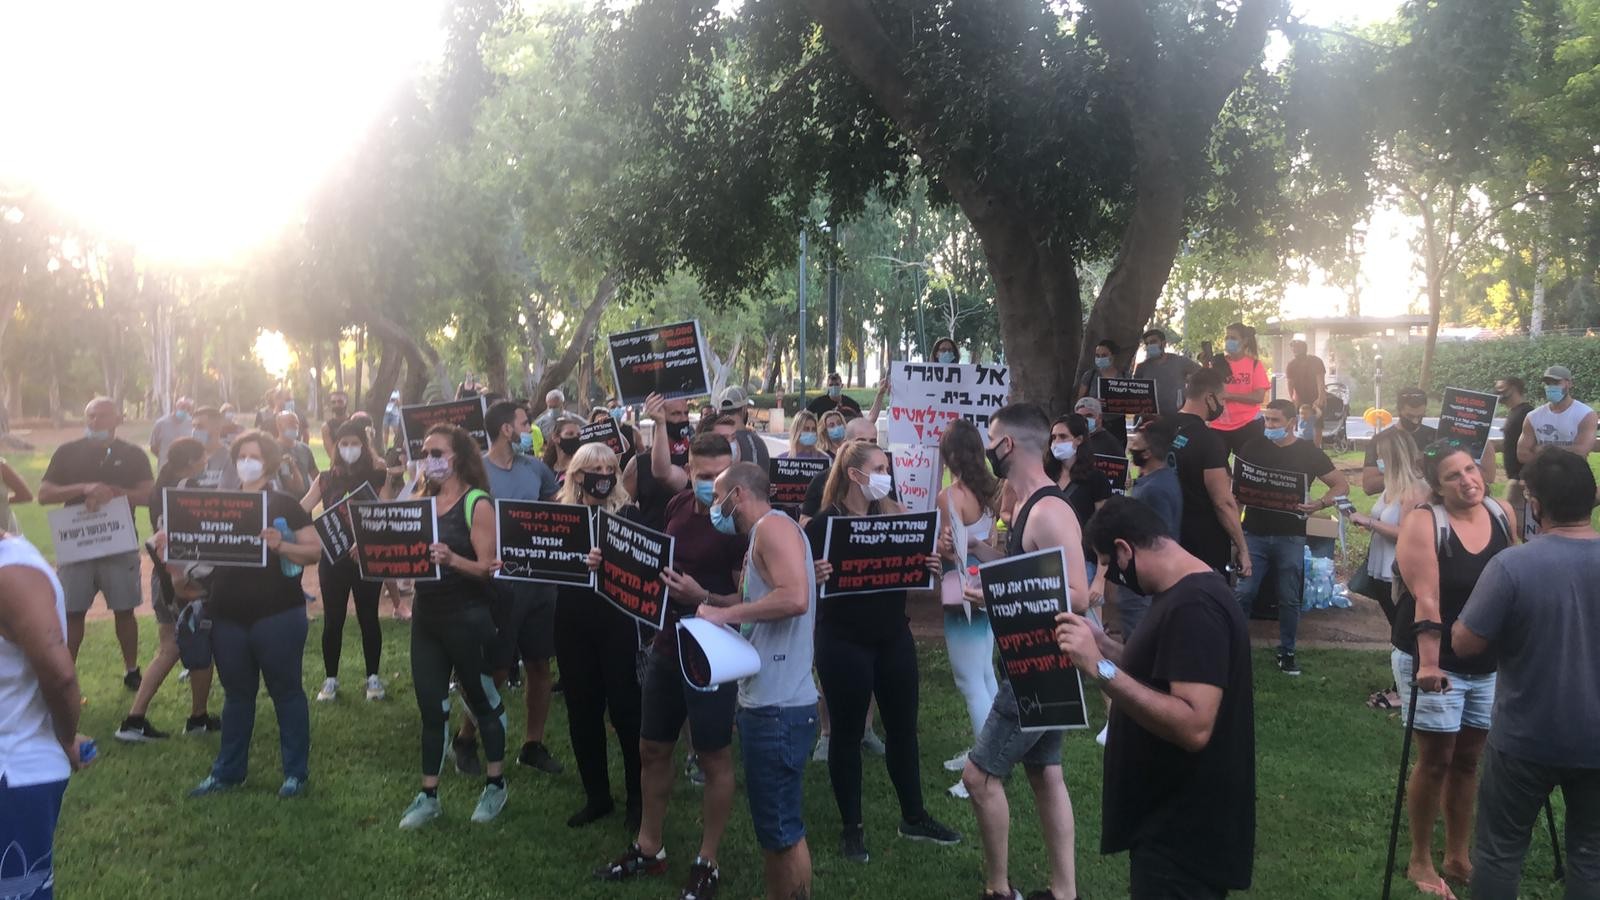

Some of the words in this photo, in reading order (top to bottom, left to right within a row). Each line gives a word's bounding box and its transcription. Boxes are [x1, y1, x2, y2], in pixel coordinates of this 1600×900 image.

[904, 365, 961, 384] תסגרו
[976, 365, 1007, 386] אל
[941, 391, 972, 406] בית
[977, 394, 1005, 407] את
[373, 508, 386, 518] את
[508, 510, 532, 519] פנאי
[535, 512, 549, 520] לא
[552, 514, 580, 524] אנחנו
[200, 521, 234, 532] אנחנו
[552, 524, 570, 534] ולא
[608, 518, 620, 533] ענף
[850, 520, 872, 533] ענף
[872, 520, 890, 531] את
[892, 520, 928, 530] שחררו
[620, 526, 632, 539] את
[849, 532, 887, 545] לעבוד!
[889, 533, 925, 544] הכושר
[532, 536, 564, 547] אנחנו
[634, 530, 662, 554] שחררו
[502, 546, 546, 558] הציבור!
[631, 546, 659, 569] הכושר
[841, 556, 903, 574] מדביקים
[905, 553, 926, 567] לא
[902, 569, 923, 583] לא
[643, 580, 660, 596] לא
[1007, 580, 1022, 594] את
[1024, 576, 1060, 592] שחררו
[988, 582, 1005, 600] ענף
[641, 600, 658, 616] לא
[1022, 598, 1059, 614] הכושר
